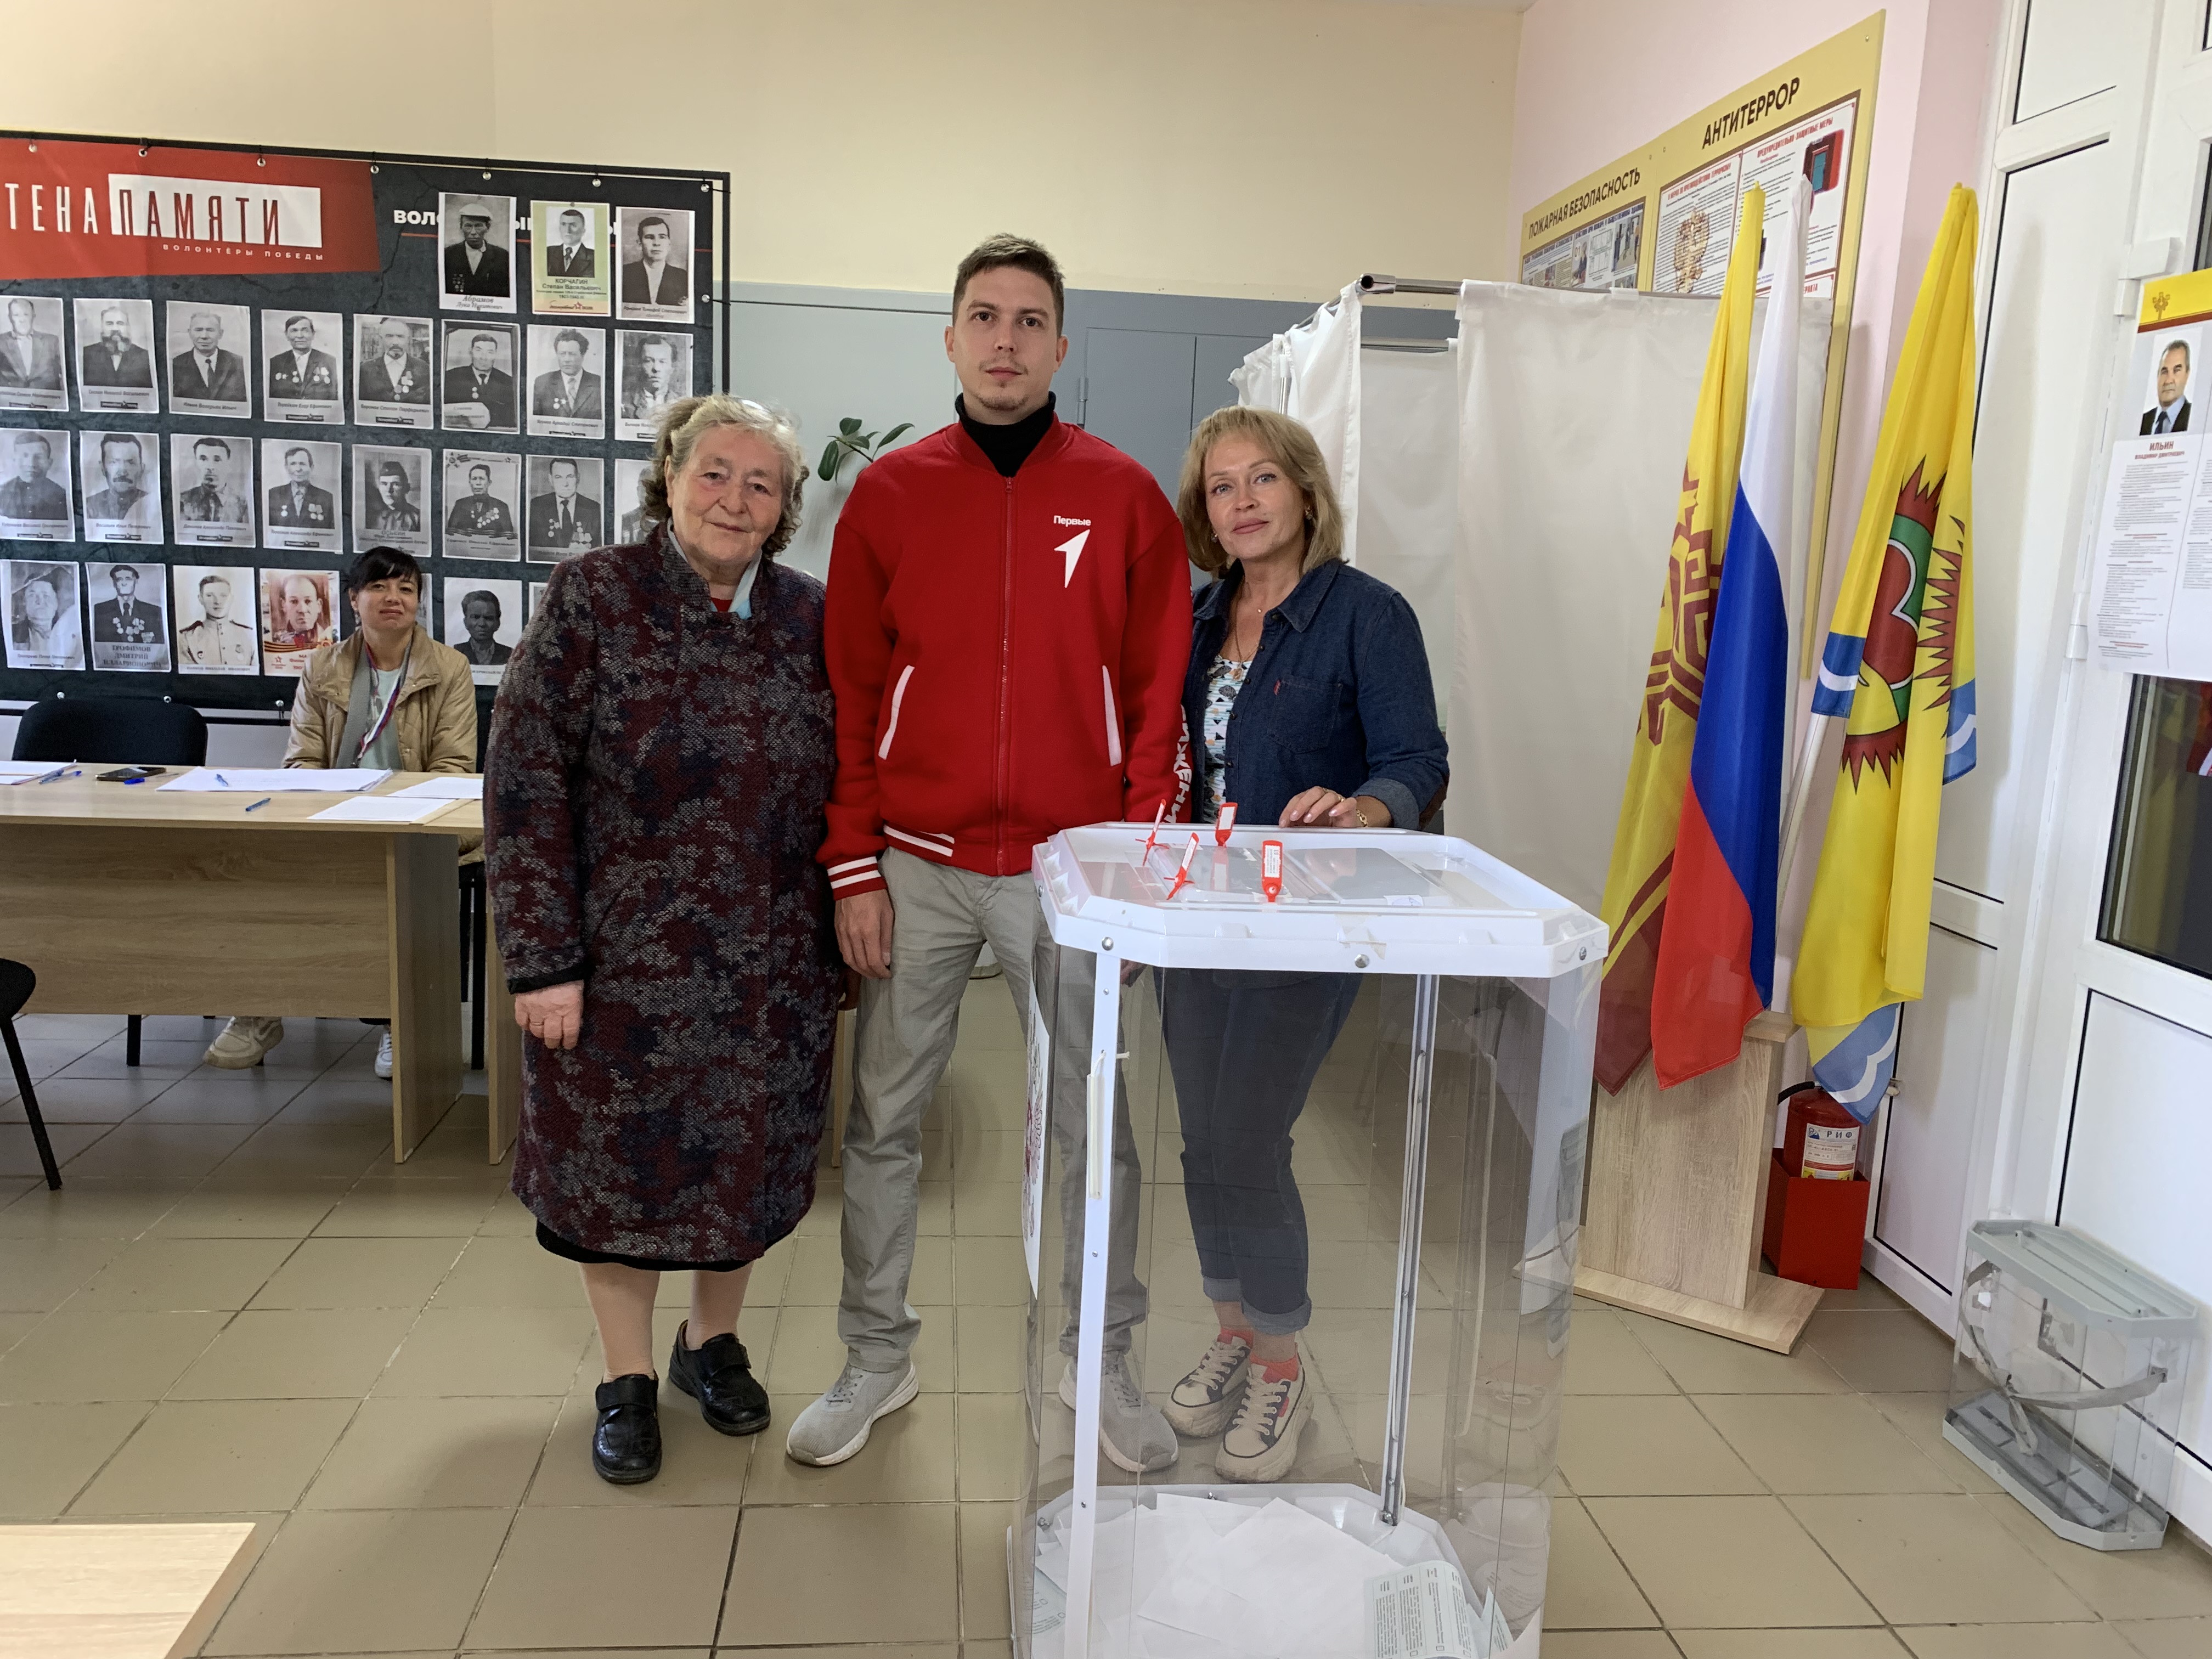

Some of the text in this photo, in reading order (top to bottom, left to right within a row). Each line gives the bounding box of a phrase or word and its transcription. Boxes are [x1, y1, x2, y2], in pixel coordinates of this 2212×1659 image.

[1702, 77, 1800, 150] АНТИТЕРРОР
[5, 183, 280, 246] ТЕНА ПАМЯТИ
[1528, 167, 1640, 240] ПОЖАРНАЯ БЕЗОПАСНОСТЬ
[162, 244, 323, 261] ВОЛОНТЁРЫ ПОБЕДЫ
[2149, 441, 2174, 451] ИЛЬИН
[1053, 515, 1092, 527] Первые
